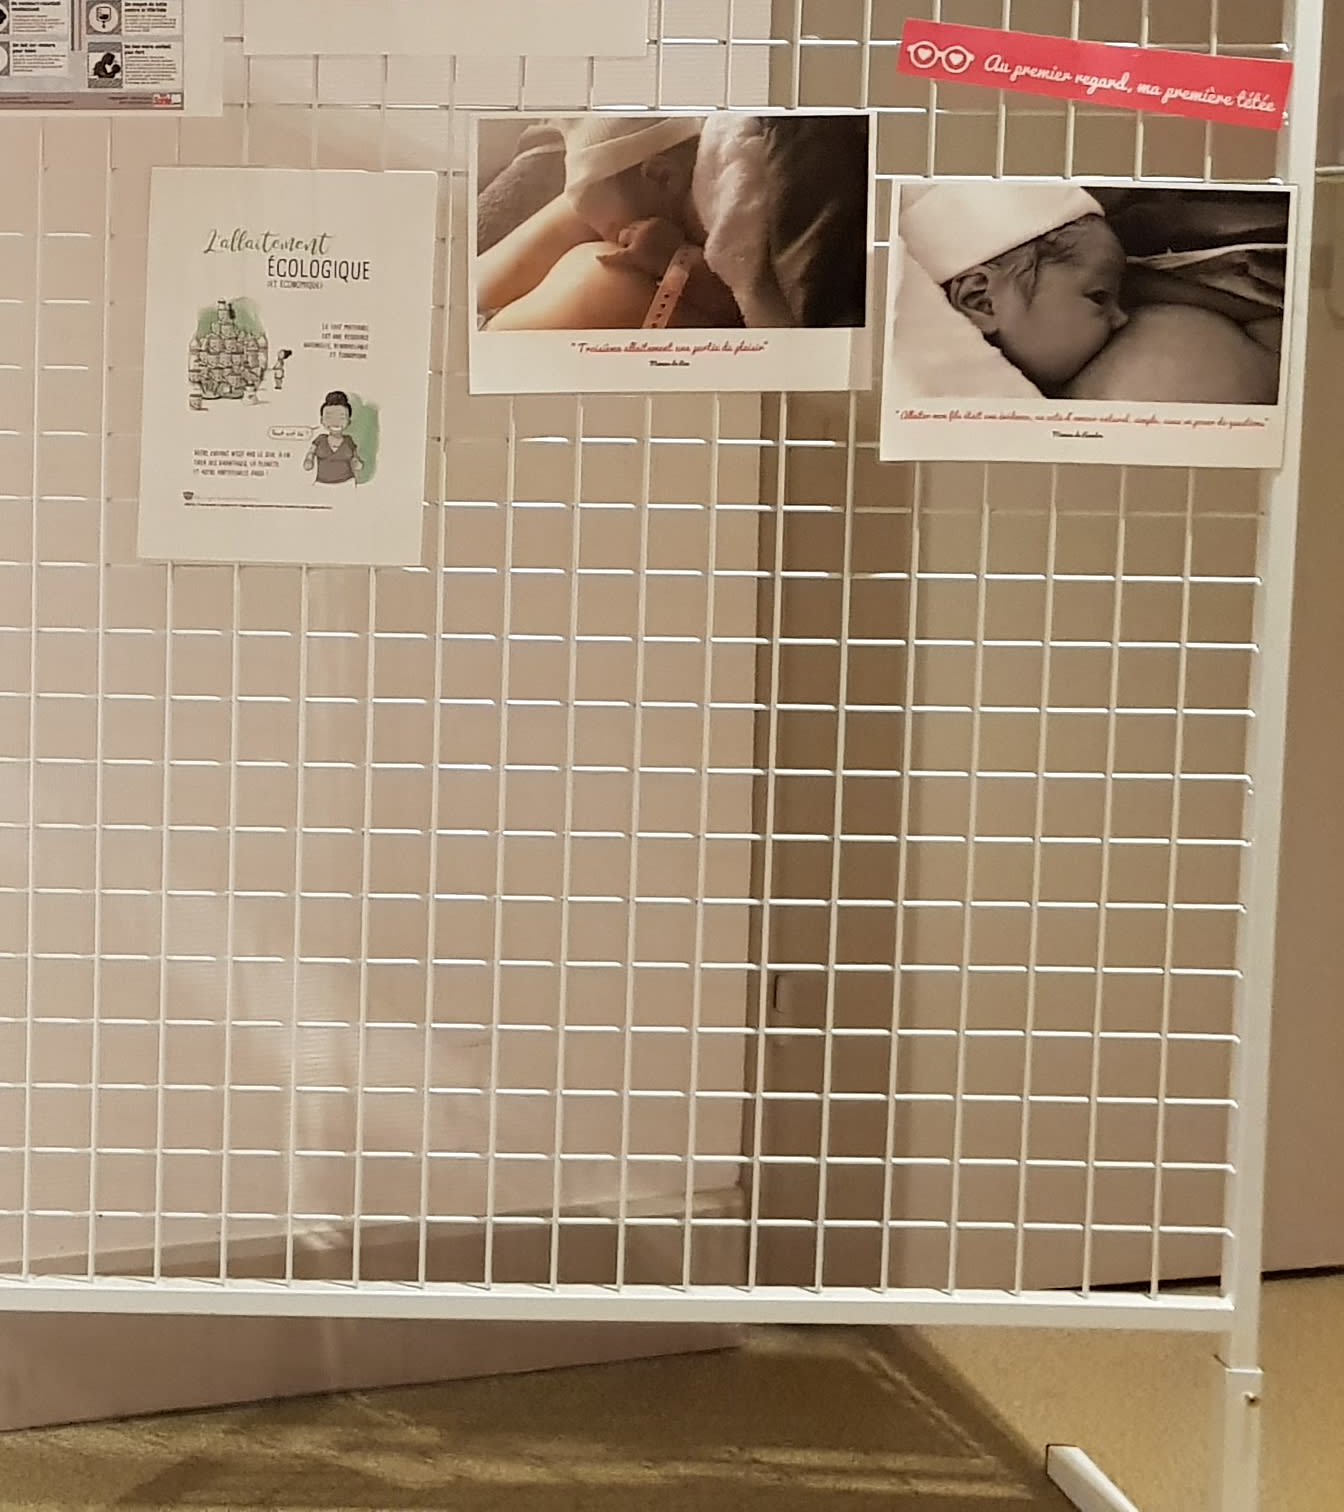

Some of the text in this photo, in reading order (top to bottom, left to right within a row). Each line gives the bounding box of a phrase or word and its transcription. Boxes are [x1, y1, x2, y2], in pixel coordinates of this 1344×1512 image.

[985, 55, 1275, 111] Au premier regard, ma première tétée
[203, 228, 335, 255] L'allaitement
[268, 256, 370, 283] ÉCOLOGIQUE
